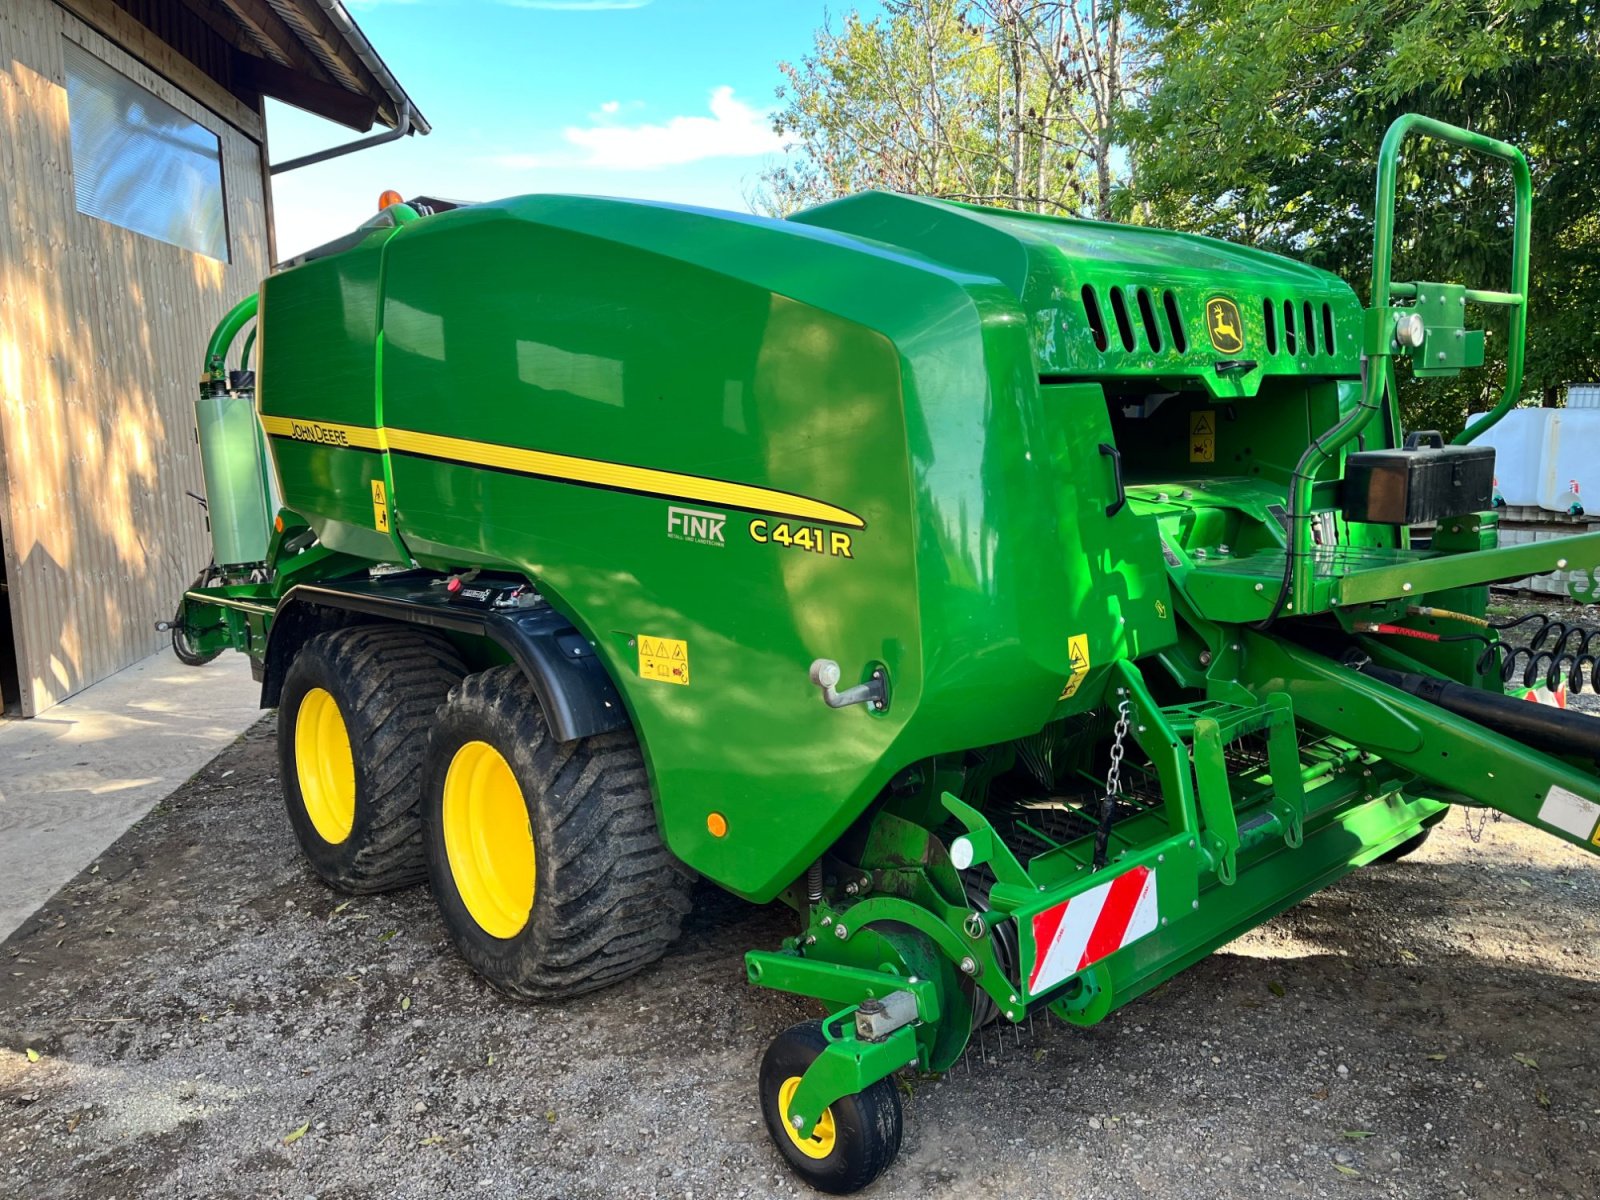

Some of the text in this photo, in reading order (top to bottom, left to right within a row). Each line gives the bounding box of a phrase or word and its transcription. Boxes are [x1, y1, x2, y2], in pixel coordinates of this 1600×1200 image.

[291, 420, 349, 445] JOHN DEERE
[667, 505, 726, 542] FINK
[749, 519, 854, 559] C 441 R
